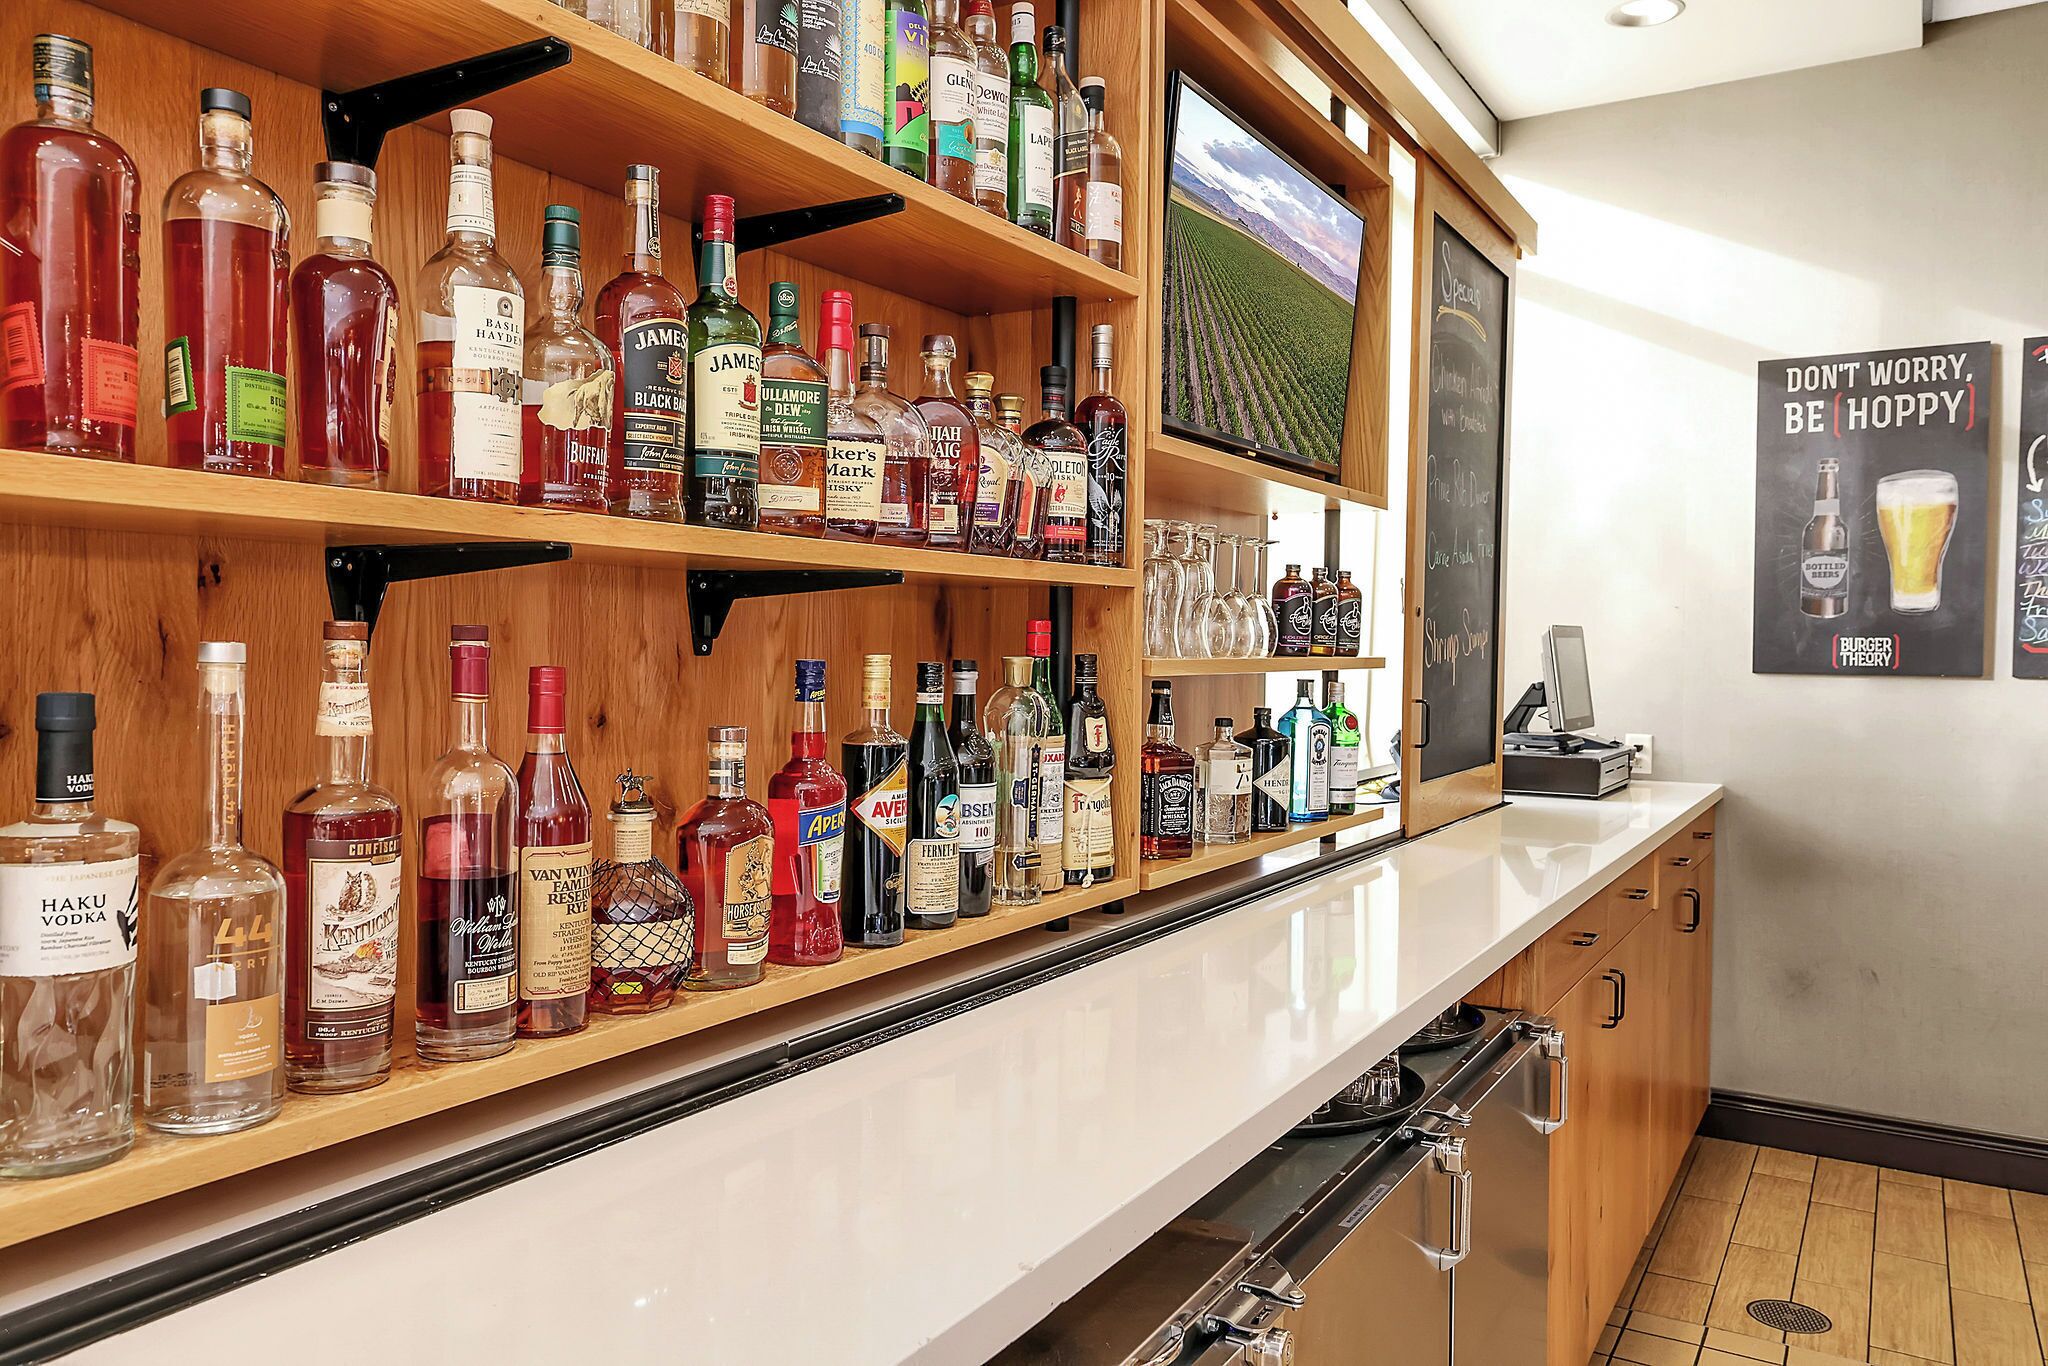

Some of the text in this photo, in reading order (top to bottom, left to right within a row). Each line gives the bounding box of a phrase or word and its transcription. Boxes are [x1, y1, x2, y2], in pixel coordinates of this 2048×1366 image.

[863, 43, 876, 55] 400
[1442, 240, 1481, 312] Specials
[485, 318, 519, 334] BASIL
[468, 346, 505, 356] KENTUCKY
[473, 353, 505, 362] BOURBON
[1432, 343, 1466, 399] Chicken
[1786, 353, 1973, 393] DON'T WORRY,
[634, 391, 672, 410] BLACK
[725, 411, 746, 420] TRIPLE
[1784, 400, 1825, 434] BE
[627, 432, 642, 440] SELECT
[729, 431, 745, 439] IRISH
[762, 424, 812, 435] IRISH WHISKEY
[1088, 428, 1123, 456] Eagle
[1106, 472, 1114, 481] 10
[1428, 530, 1449, 570] Carne
[1452, 527, 1474, 565] Asada
[1805, 562, 1846, 571] BOTTLED
[1811, 570, 1840, 579] BEERS
[1840, 637, 1893, 652] BURGER
[1425, 617, 1459, 686] Shrimp
[1840, 651, 1893, 667] THEORY
[223, 724, 236, 788] NORTH
[1159, 780, 1172, 793] JACK
[960, 802, 994, 818] BSEN
[975, 826, 989, 838] 110
[69, 870, 113, 883] JAPANESE
[529, 868, 562, 881] VAN
[42, 893, 107, 913] HAKU
[566, 902, 588, 915] RYE
[42, 910, 107, 927] VODKA
[727, 902, 755, 922] HORSE
[322, 903, 397, 953] KENTUCKY
[450, 915, 502, 937] William
[41, 931, 64, 939] Distilled
[552, 927, 585, 939] STRAIGHT
[476, 929, 513, 953] Weller
[464, 958, 497, 968] KENTUCKY
[467, 965, 497, 975] BOURBON
[340, 1026, 379, 1036] KENTUCKY
